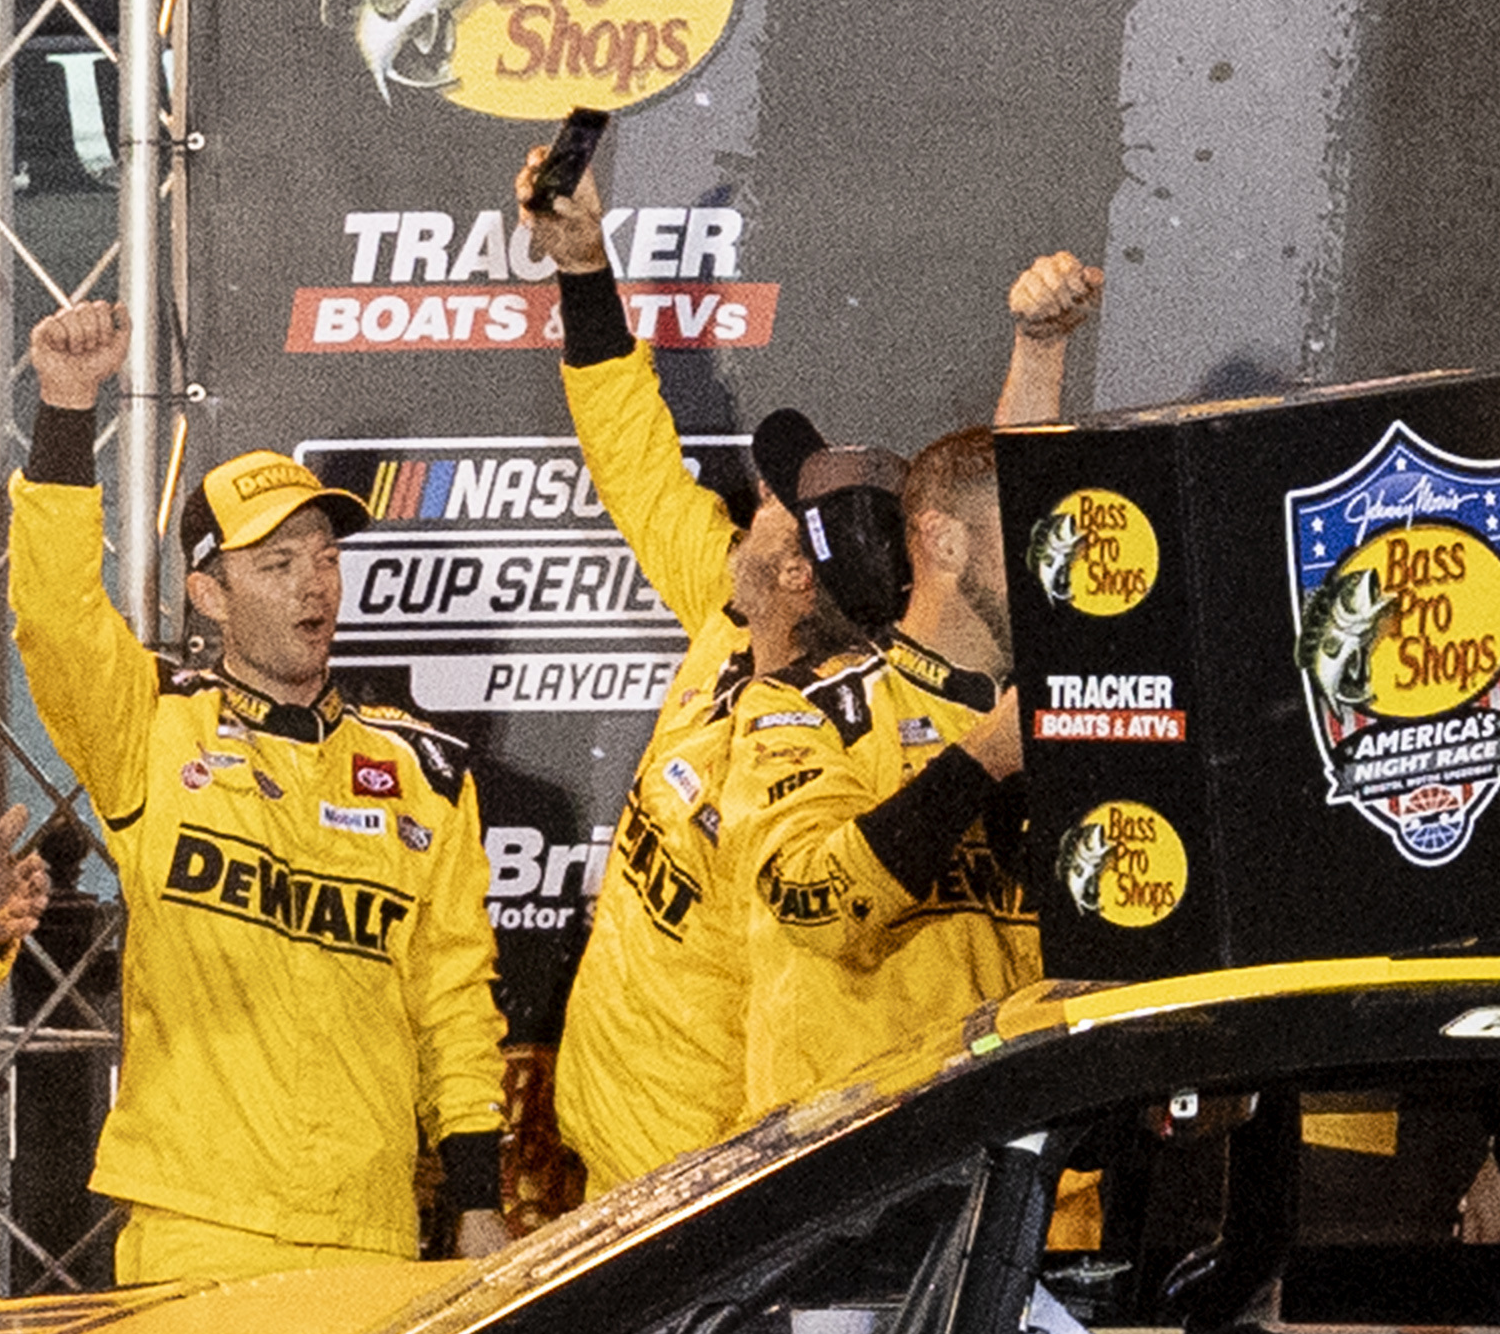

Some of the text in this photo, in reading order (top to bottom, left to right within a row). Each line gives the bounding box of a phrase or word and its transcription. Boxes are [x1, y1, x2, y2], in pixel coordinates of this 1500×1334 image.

[495, 4, 691, 95] Shops
[313, 294, 529, 344] BOATS
[626, 292, 747, 340] TVs
[1078, 494, 1128, 531] Bass
[1082, 528, 1121, 563] Pro
[1383, 539, 1467, 593] Bass
[359, 555, 676, 614] CUP SERIE
[1086, 562, 1147, 601] Shops
[1395, 592, 1454, 640] Pro
[484, 661, 674, 702] PLAYOFF
[1395, 632, 1497, 691] Shops
[1047, 675, 1174, 710] TRACKER
[1041, 715, 1179, 738] BOATS & ATVs
[1353, 712, 1496, 759] AMERICA'S
[1354, 740, 1499, 782] NIGHT RACE
[1107, 807, 1157, 843] Bass
[1112, 842, 1150, 874] Pro
[165, 828, 411, 958] DEWALT
[1114, 873, 1177, 916] Shops
[485, 903, 575, 929] otor
